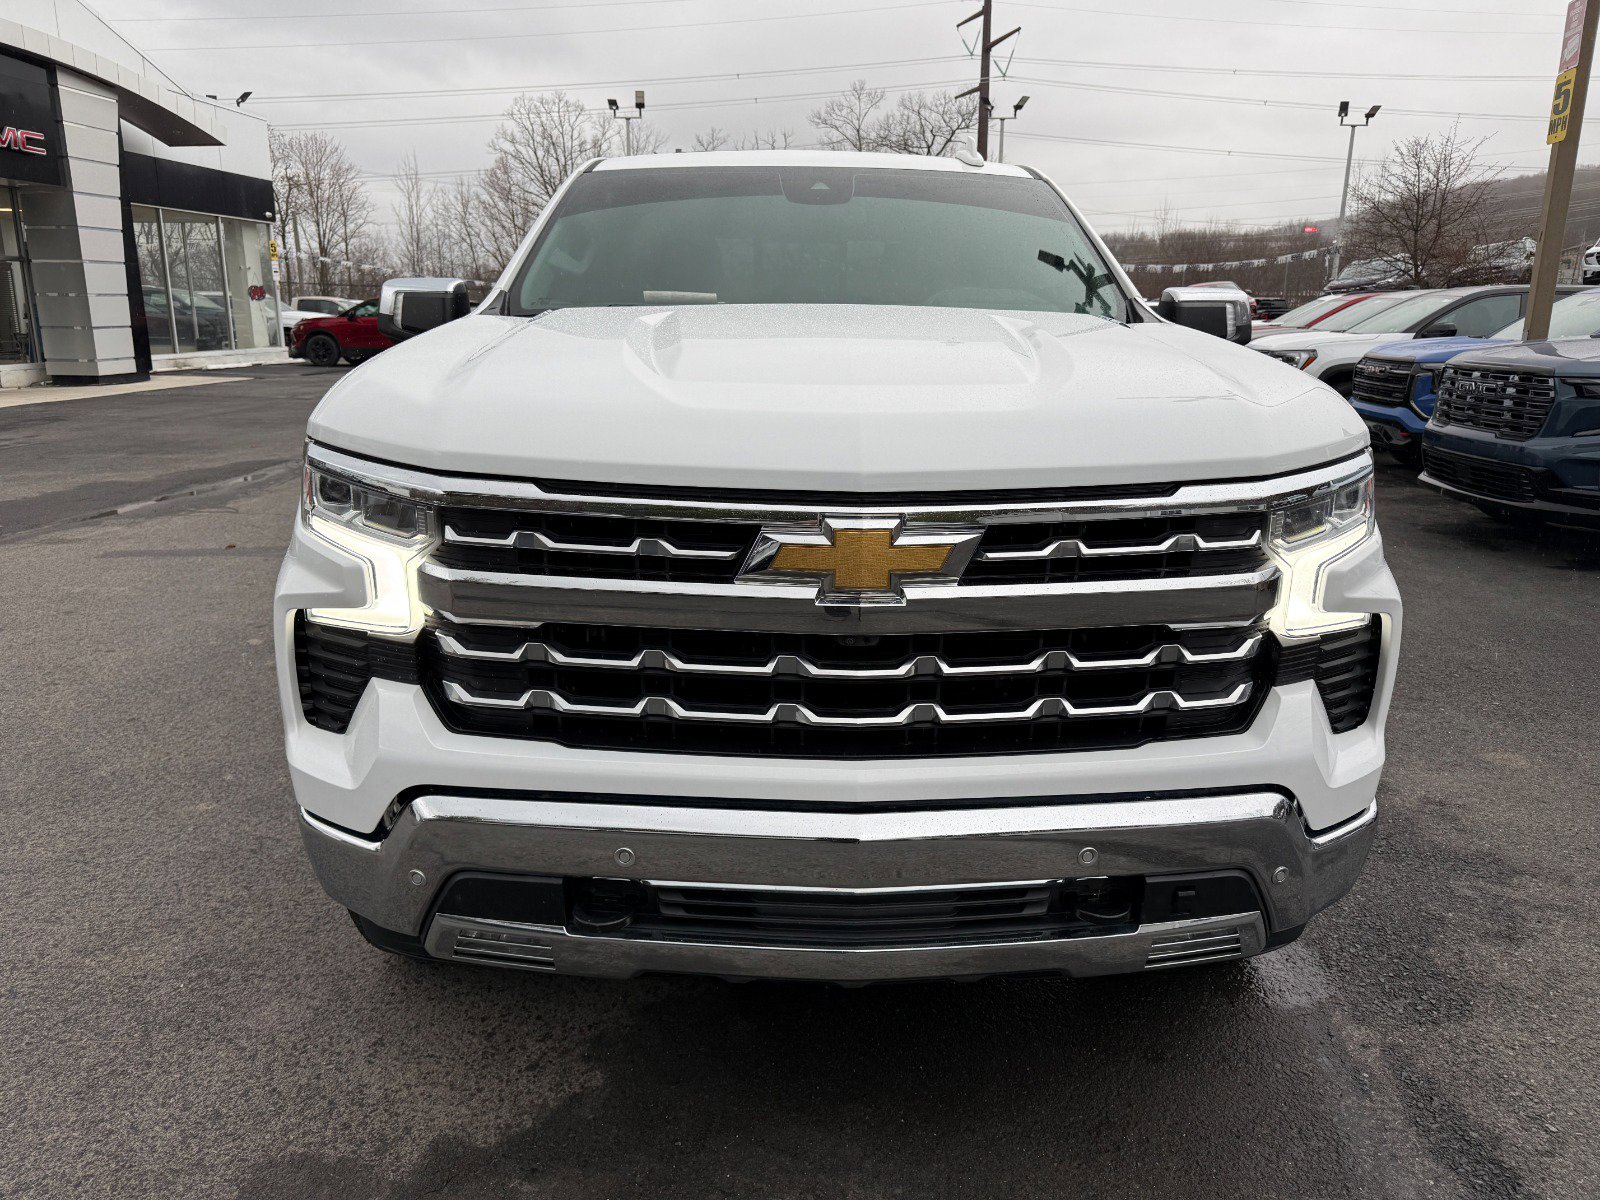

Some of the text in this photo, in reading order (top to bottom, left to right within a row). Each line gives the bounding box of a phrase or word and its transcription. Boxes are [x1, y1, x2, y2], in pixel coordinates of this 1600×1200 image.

[1553, 79, 1571, 115] 5
[1548, 115, 1568, 135] MPH
[270, 243, 277, 252] 5
[1457, 380, 1496, 396] GMC
